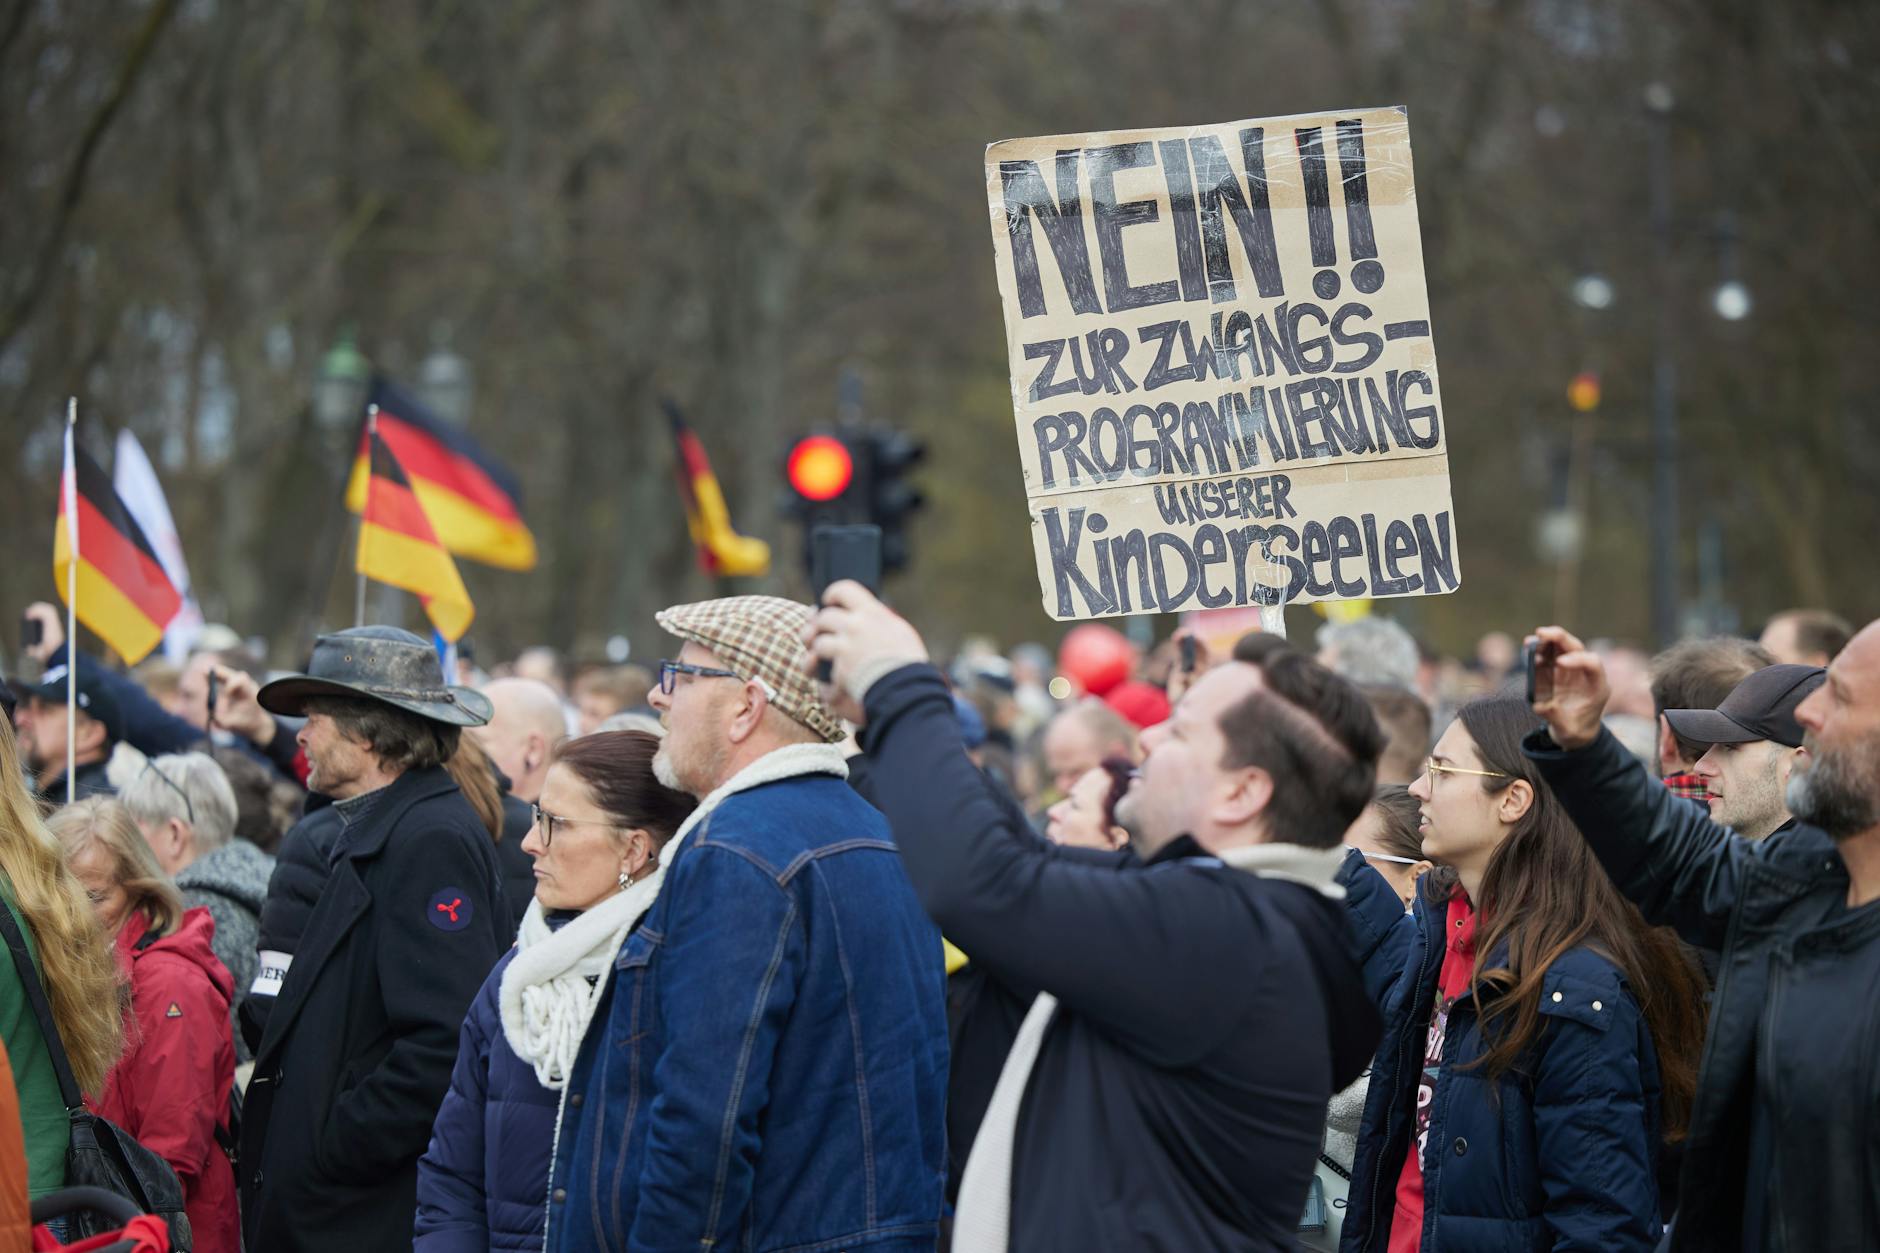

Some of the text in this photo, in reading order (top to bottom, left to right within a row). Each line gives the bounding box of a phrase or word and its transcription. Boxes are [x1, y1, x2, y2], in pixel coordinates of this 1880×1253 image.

[1022, 300, 1431, 404] ZUR ZWANGS-
[1033, 370, 1439, 490] PROGRAMMIERUNG
[1153, 474, 1298, 527] UNSERER
